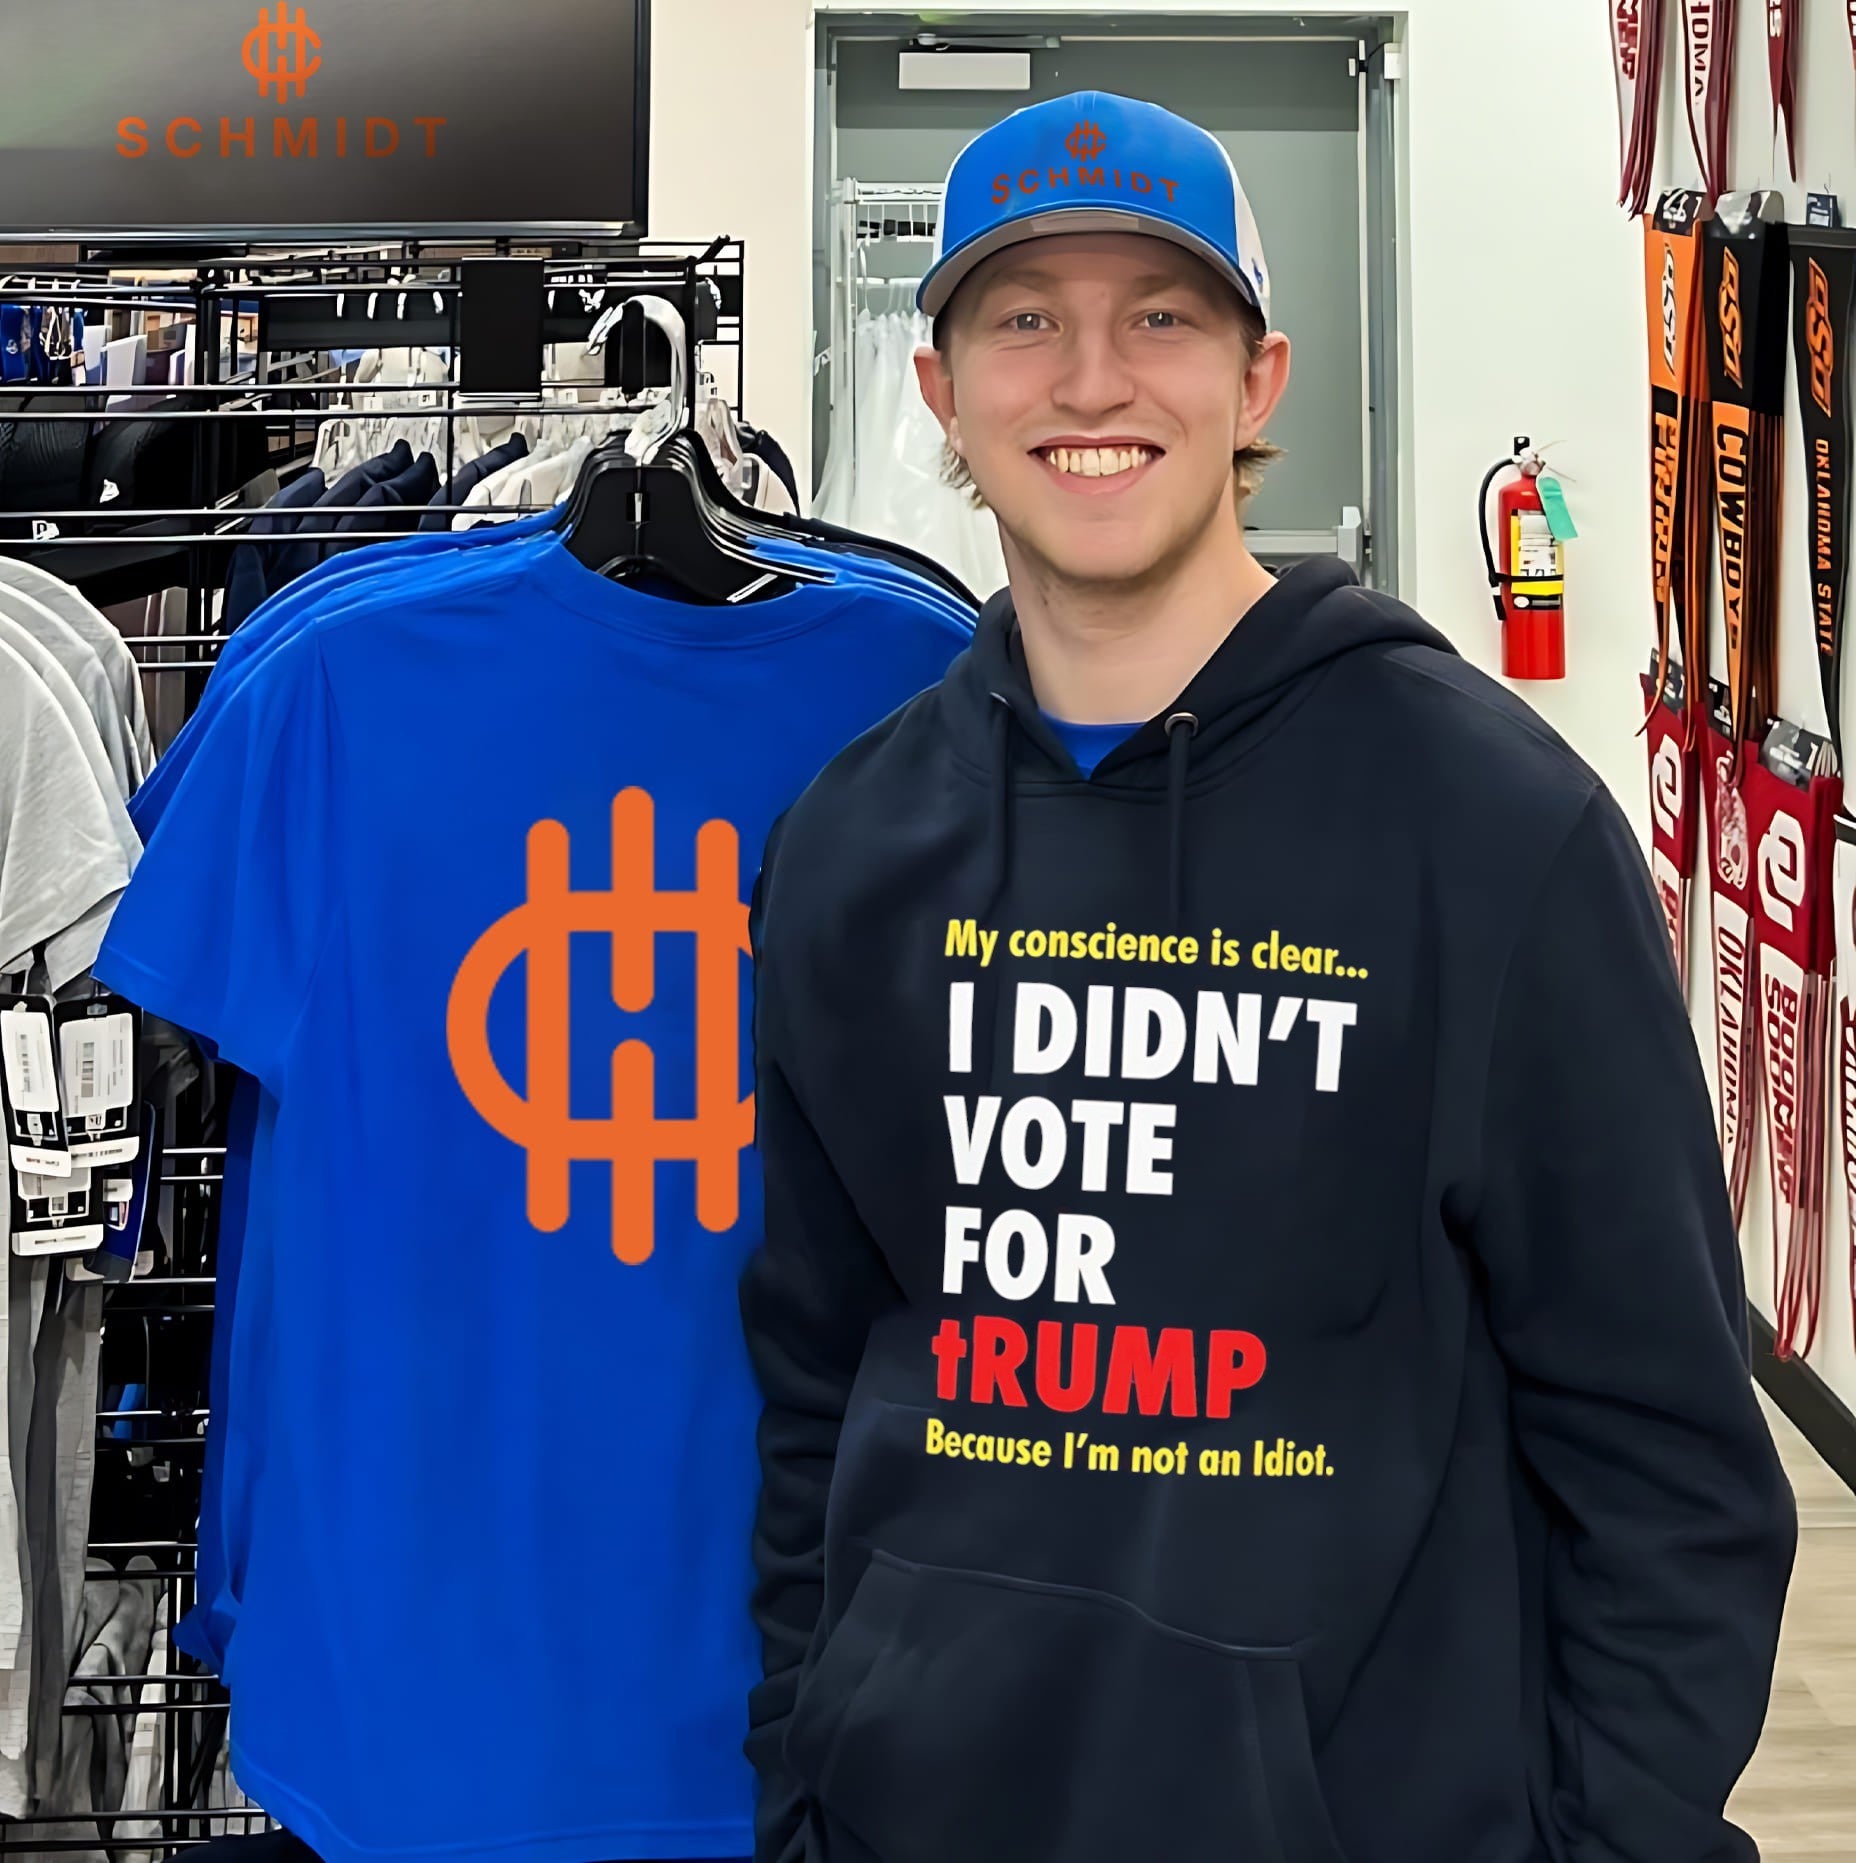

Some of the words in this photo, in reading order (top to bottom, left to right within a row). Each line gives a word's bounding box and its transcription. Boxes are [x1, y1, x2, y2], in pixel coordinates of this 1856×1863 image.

[116, 117, 447, 158] SCHMIDT
[992, 167, 1179, 204] SCHMIDT
[1815, 438, 1832, 570] OKLAHOMA
[945, 918, 999, 967] My
[1008, 922, 1199, 965] conscience
[1211, 928, 1240, 967] is
[1251, 930, 1369, 980] clear...
[949, 981, 975, 1073] I
[1012, 981, 1358, 1093] DIDN'T
[943, 1095, 1177, 1196] VOTE
[942, 1206, 1117, 1305] FOR
[931, 1315, 1267, 1419] tRUMP
[925, 1418, 1052, 1468] Because
[1063, 1432, 1120, 1472] I'm
[1131, 1442, 1189, 1476] not
[1198, 1449, 1241, 1477] an
[1253, 1438, 1335, 1477] Idiot.
